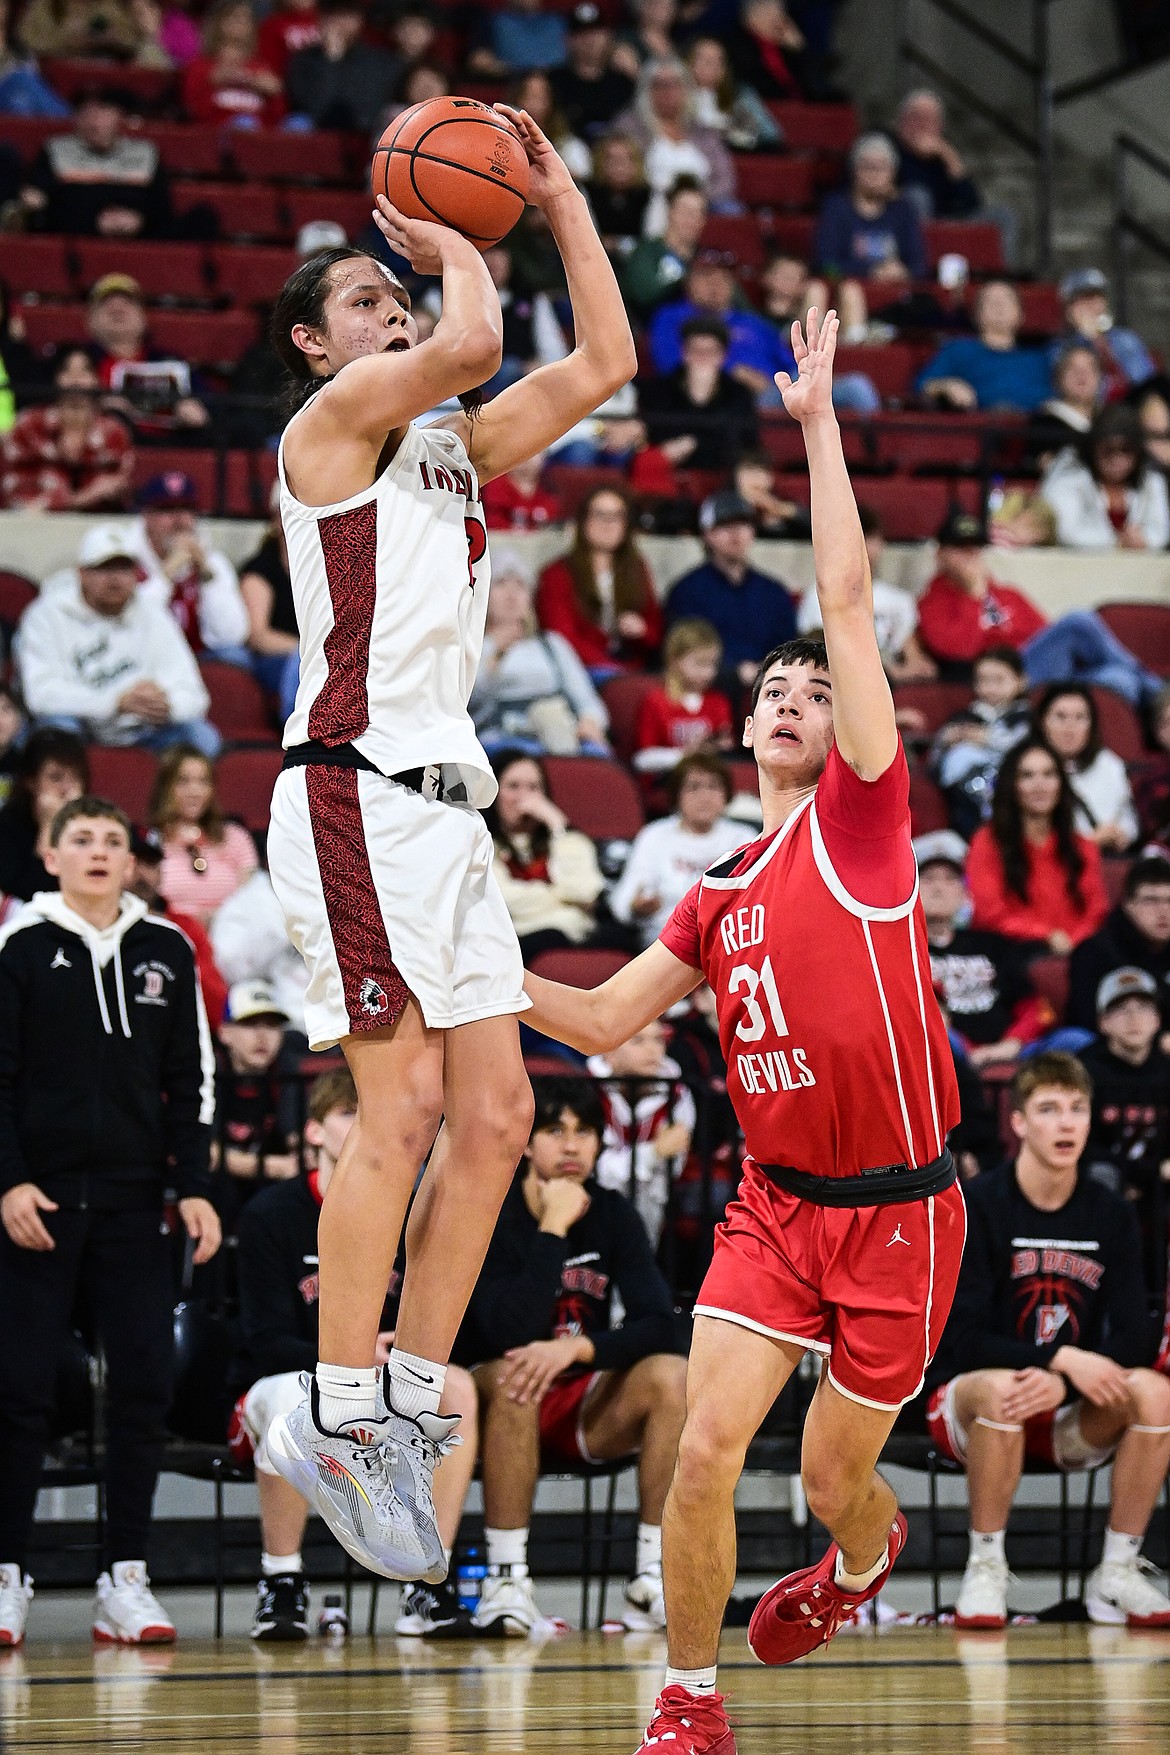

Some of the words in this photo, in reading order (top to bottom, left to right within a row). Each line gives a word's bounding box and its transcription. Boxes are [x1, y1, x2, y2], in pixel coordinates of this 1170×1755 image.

[720, 904, 766, 956] RED
[728, 954, 790, 1043] 31
[737, 1048, 817, 1094] DEVILS
